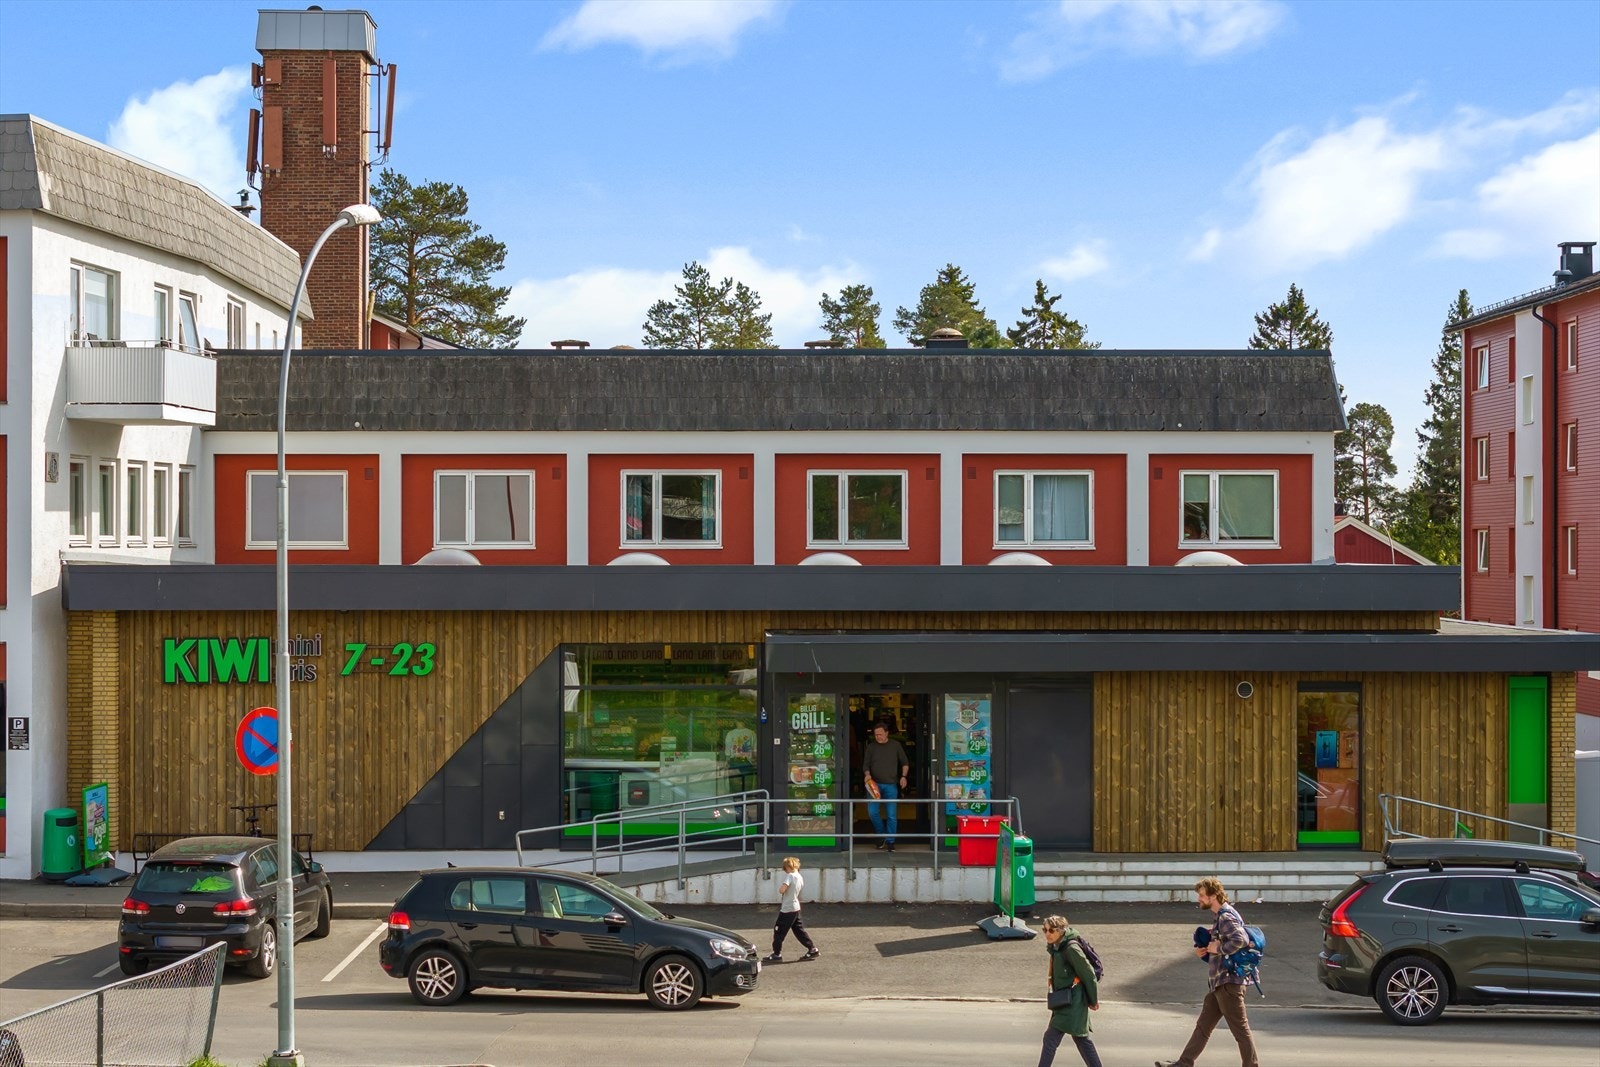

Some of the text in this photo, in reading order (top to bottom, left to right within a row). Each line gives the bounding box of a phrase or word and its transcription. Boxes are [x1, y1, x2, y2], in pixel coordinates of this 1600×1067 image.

[163, 637, 270, 684] KIWI
[286, 658, 318, 683] ris
[791, 711, 831, 730] GRILL-
